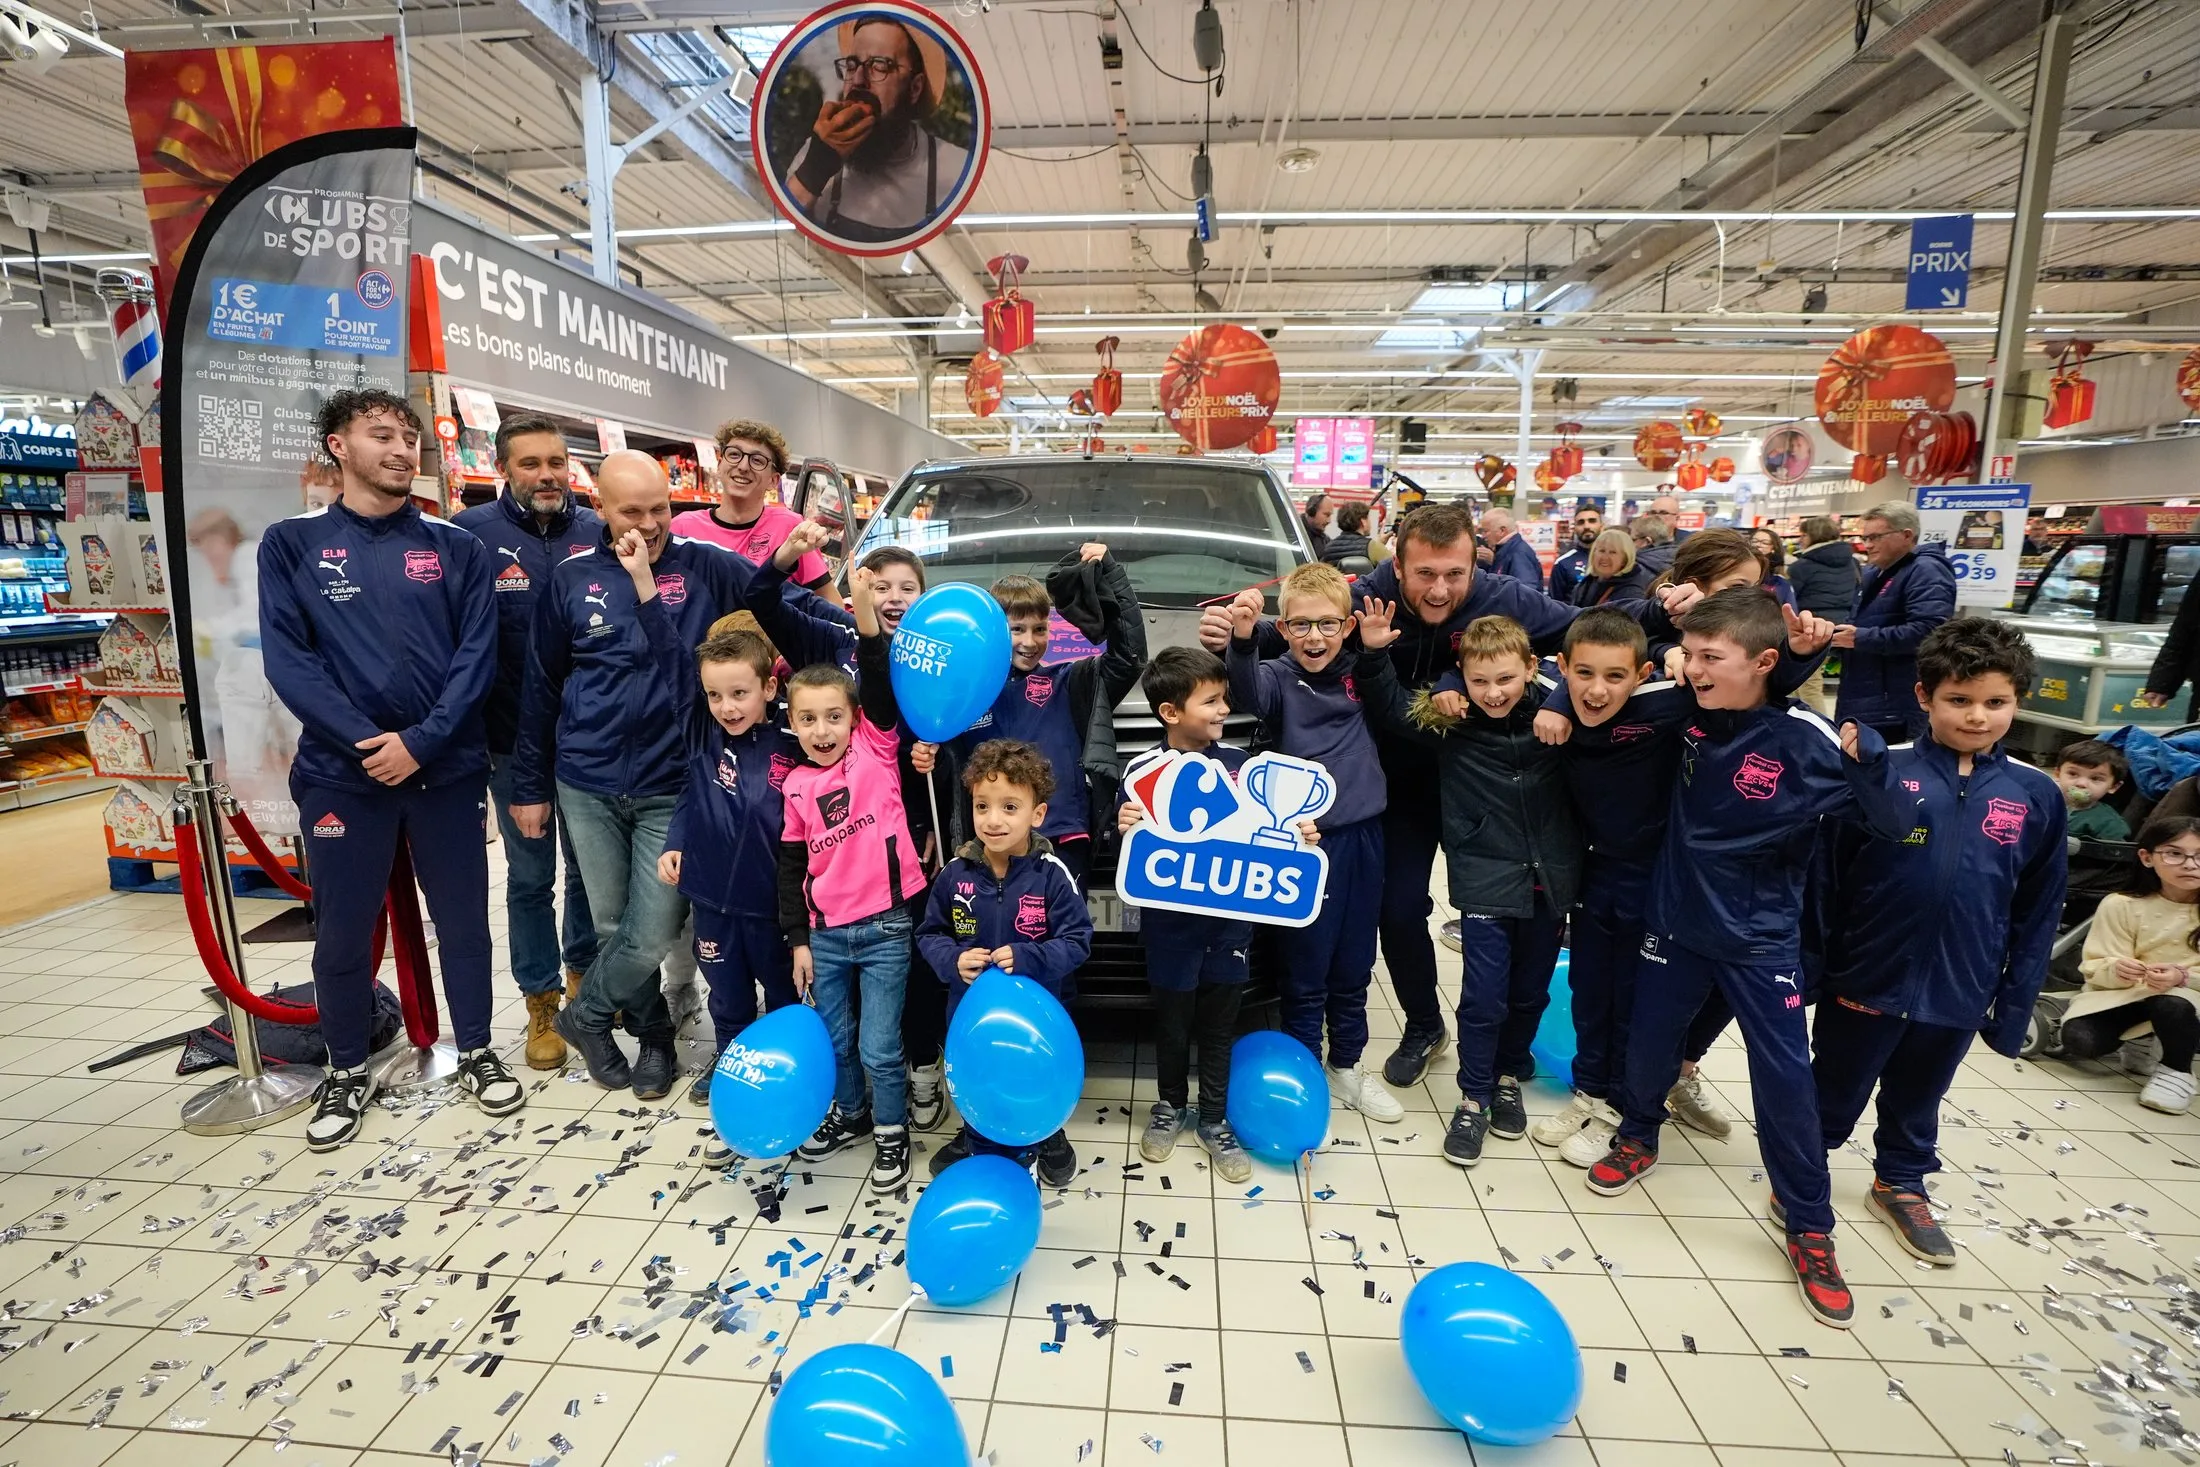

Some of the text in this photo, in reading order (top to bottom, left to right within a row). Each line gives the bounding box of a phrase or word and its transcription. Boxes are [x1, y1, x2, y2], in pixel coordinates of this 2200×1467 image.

[314, 188, 365, 200] PROGRAMME
[264, 227, 411, 266] DE SPORT
[1911, 251, 1970, 273] PRIX
[366, 280, 379, 288] ACT
[326, 292, 341, 318] 1
[213, 306, 285, 327] D'ACHAT
[430, 241, 728, 391] C'EST MAINTENANT
[213, 321, 254, 333] EN FRUITS
[324, 317, 378, 336] POINT
[324, 332, 391, 346] POUR VOTRE CLUB
[324, 339, 387, 352] DE SPORT FAVORI
[238, 350, 366, 374] Des dotations gratuites
[475, 323, 523, 363] bons
[528, 343, 572, 377] plans
[574, 360, 594, 383] du
[597, 367, 653, 398] moment
[209, 360, 237, 372] pour
[238, 362, 265, 374] votre
[268, 365, 291, 377] club
[293, 366, 324, 380] grâce
[327, 371, 335, 382] à
[337, 373, 355, 384] vos
[196, 369, 208, 379] et
[210, 371, 227, 382] un
[229, 372, 275, 387] minibus
[278, 376, 284, 388] à
[286, 379, 327, 393] gagner
[1181, 392, 1259, 408] JOYEUX NOËL
[1838, 396, 1929, 411] JOYEUX NOËL
[273, 422, 285, 432] et
[22, 444, 63, 457] CORPS
[272, 448, 307, 461] dans
[322, 548, 347, 558] ELM
[495, 578, 530, 586] DORAS
[588, 583, 603, 593] NL
[1052, 645, 1100, 653] Saône
[895, 648, 948, 677] SPORT
[313, 825, 346, 833] DORAS
[1144, 848, 1303, 905] CLUBS
[957, 882, 974, 894] YM
[1785, 995, 1801, 1009] HM
